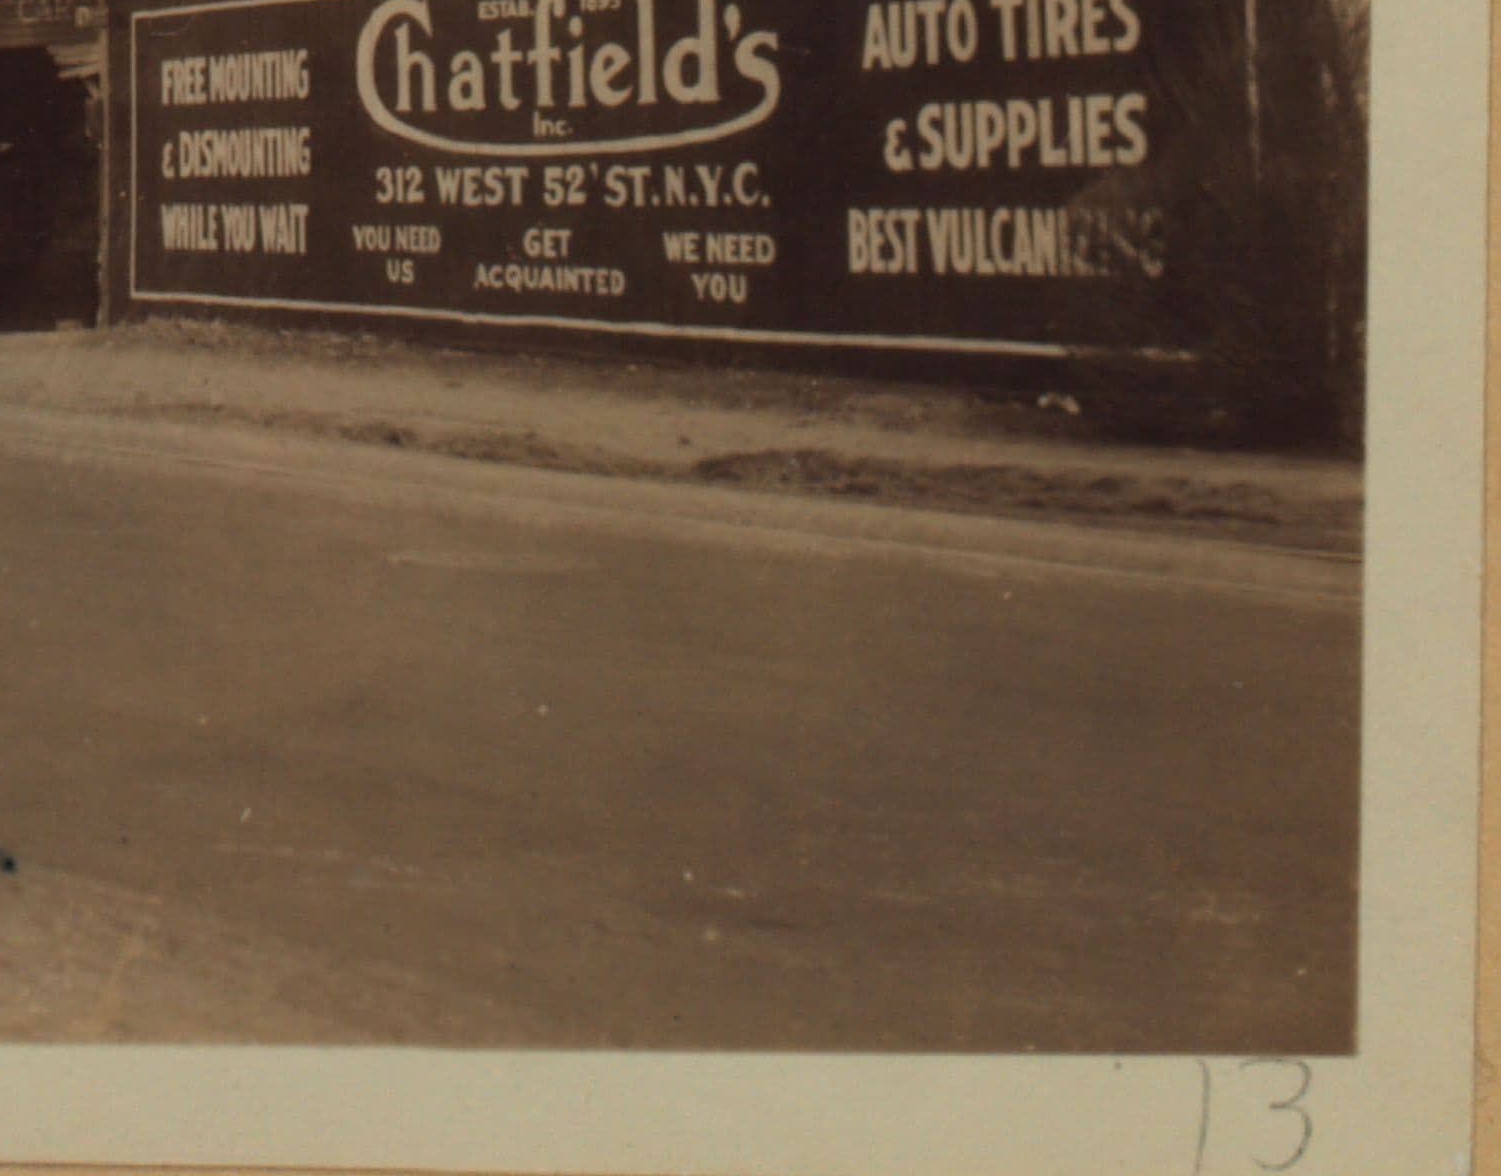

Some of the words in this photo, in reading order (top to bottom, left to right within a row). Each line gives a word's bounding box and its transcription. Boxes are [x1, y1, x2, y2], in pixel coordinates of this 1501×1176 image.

[161, 56, 207, 105] FREE
[209, 48, 311, 101] MOUNTING
[533, 111, 574, 137] Inc.
[884, 118, 914, 172] &
[916, 93, 1149, 171] SUPPLIES
[161, 141, 175, 179] &
[179, 127, 312, 179] DISMOUNTING
[375, 165, 426, 204] 312
[435, 166, 530, 206] WEST
[161, 203, 218, 251] WHILE
[220, 204, 256, 252] YOU
[259, 203, 309, 254] WAIT
[352, 225, 391, 252] YOU
[395, 226, 442, 254] NEED
[522, 228, 572, 259] GET
[848, 206, 920, 274] BEST
[663, 232, 700, 263] WE
[706, 232, 776, 265] NEED
[386, 260, 415, 284] US
[473, 264, 626, 295] ACQUAINTED
[691, 272, 748, 303] YOU
